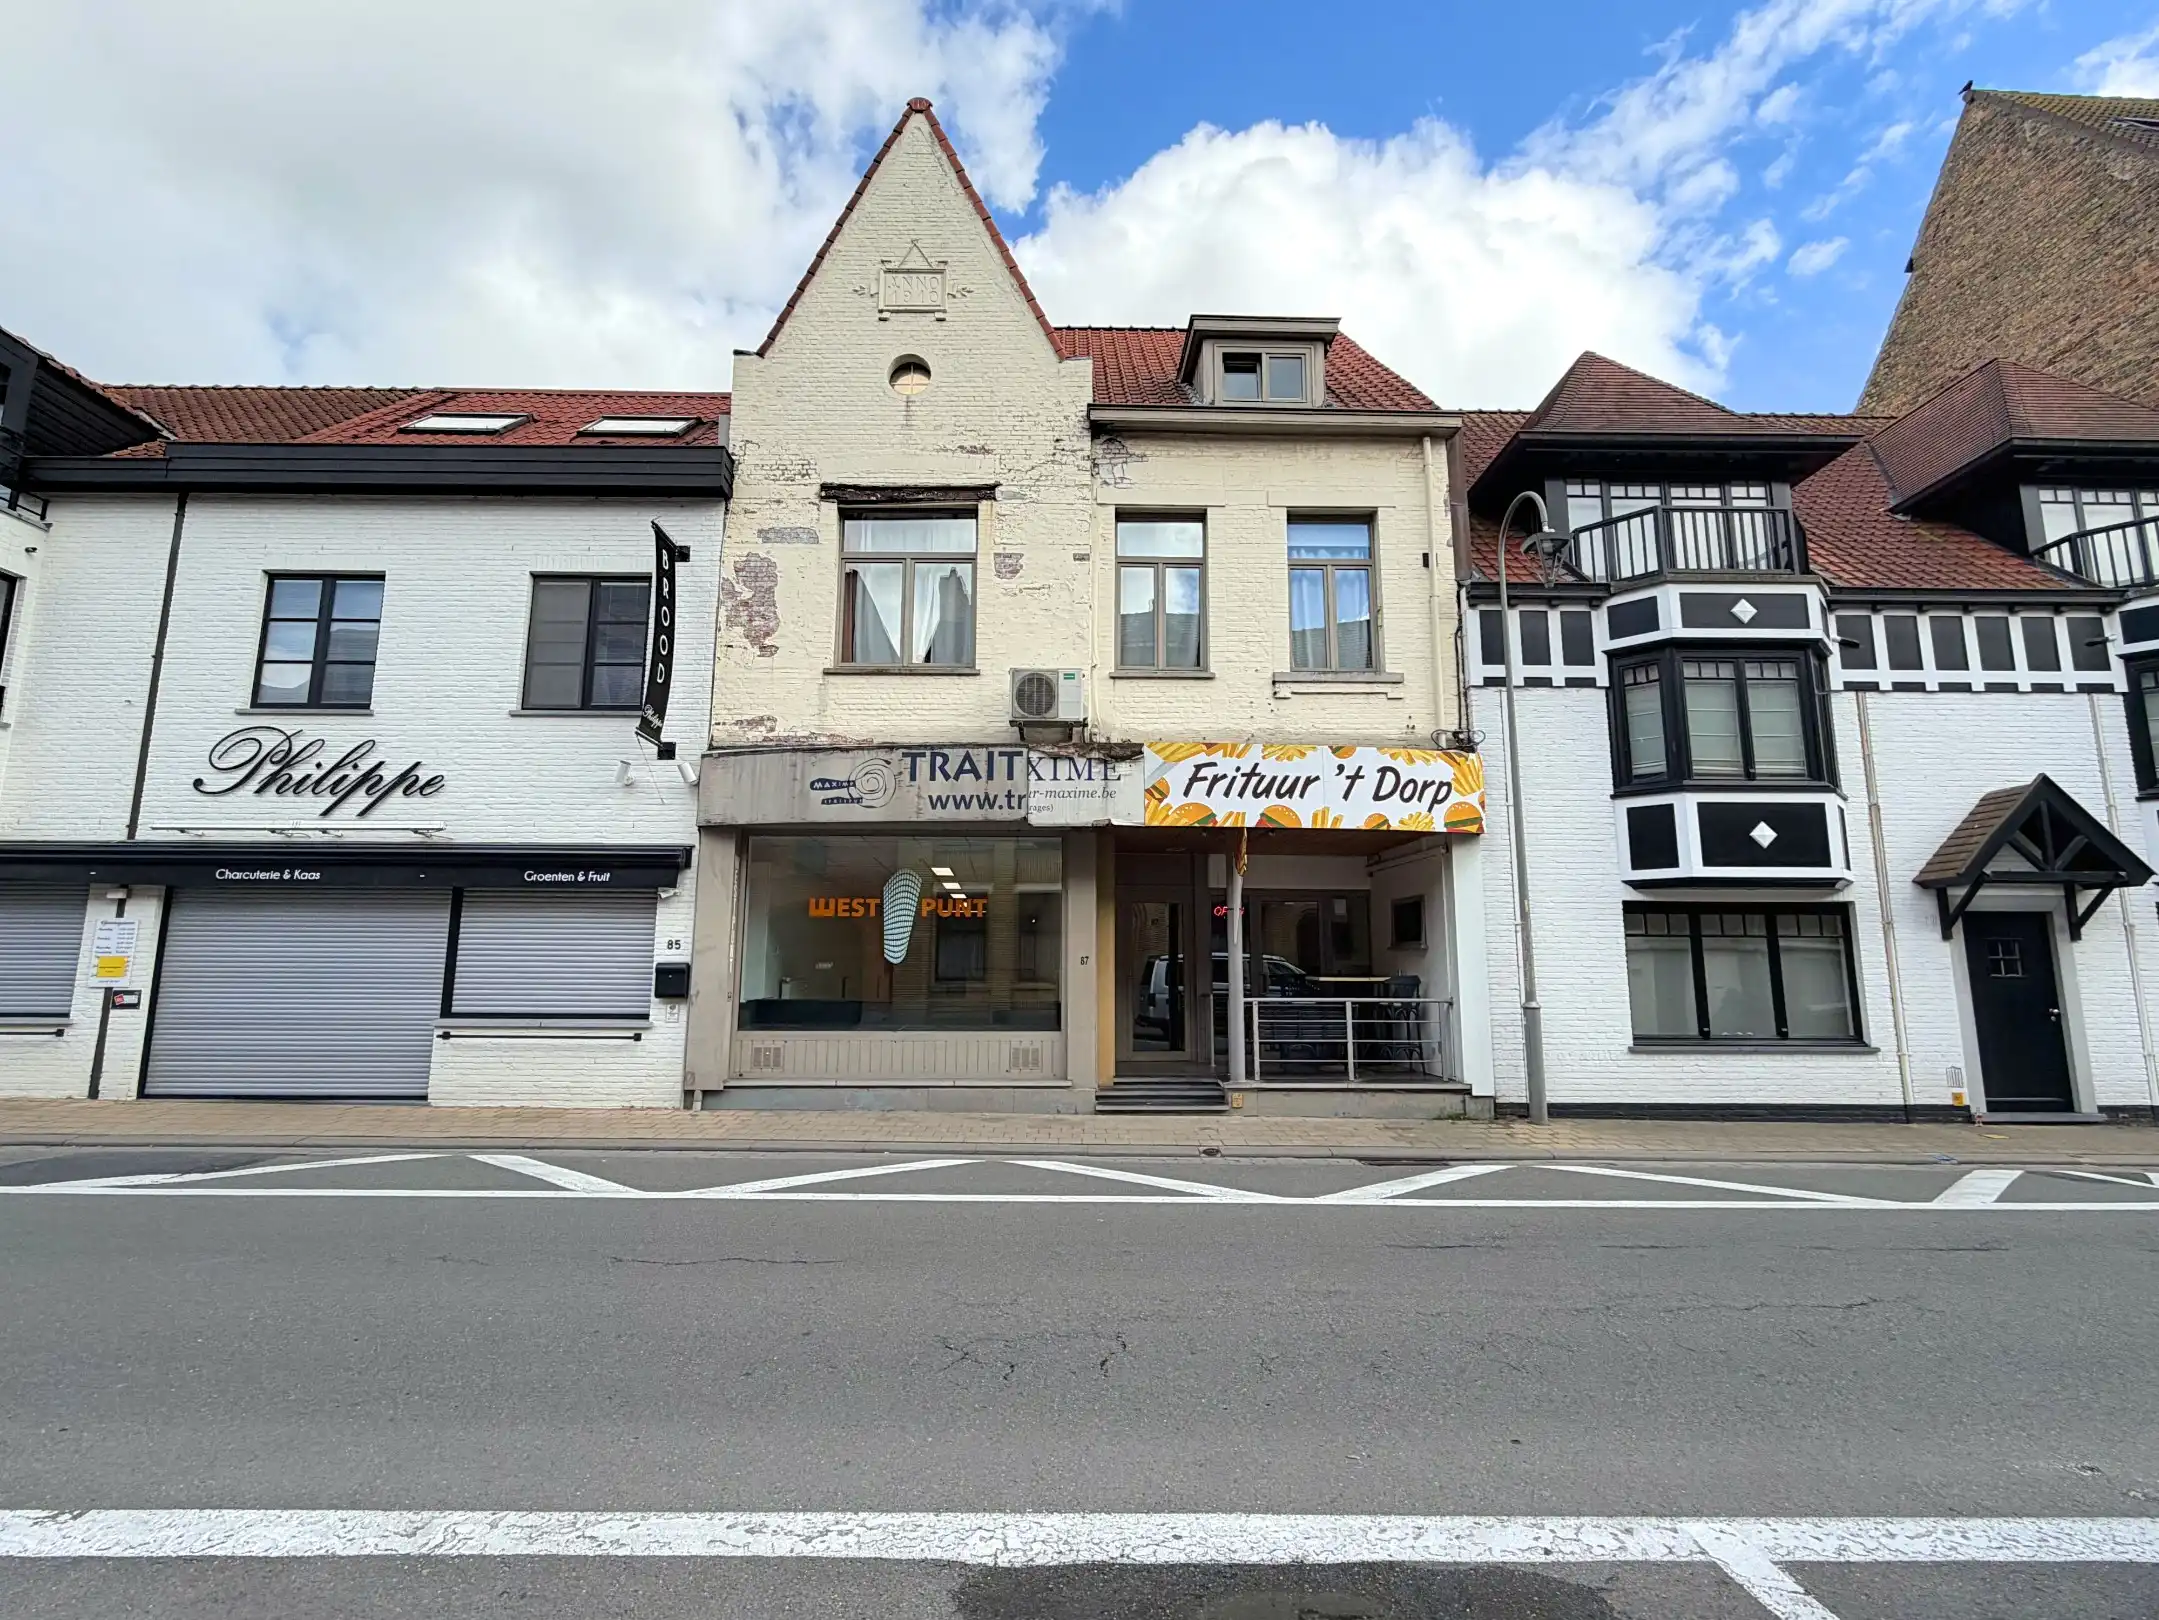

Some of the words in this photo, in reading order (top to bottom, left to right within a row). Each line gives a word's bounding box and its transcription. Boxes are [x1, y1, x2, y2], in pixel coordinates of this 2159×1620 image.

[887, 276, 940, 290] ANNO
[656, 549, 670, 684] BROOD
[193, 725, 445, 817] Philippe
[902, 750, 1024, 782] TRAIT
[1182, 761, 1322, 801] Frituur
[1334, 763, 1365, 803] 't
[1372, 765, 1453, 813] Dorp
[215, 868, 280, 880] Charcuterie
[283, 869, 292, 880] &
[293, 869, 321, 880] Kaas
[524, 870, 575, 882] Groenten
[577, 871, 586, 882] &
[588, 871, 611, 882] Fruit
[808, 897, 881, 918] WEST
[921, 898, 988, 918] PUNT
[667, 940, 681, 950] 85
[1080, 956, 1090, 966] 87
